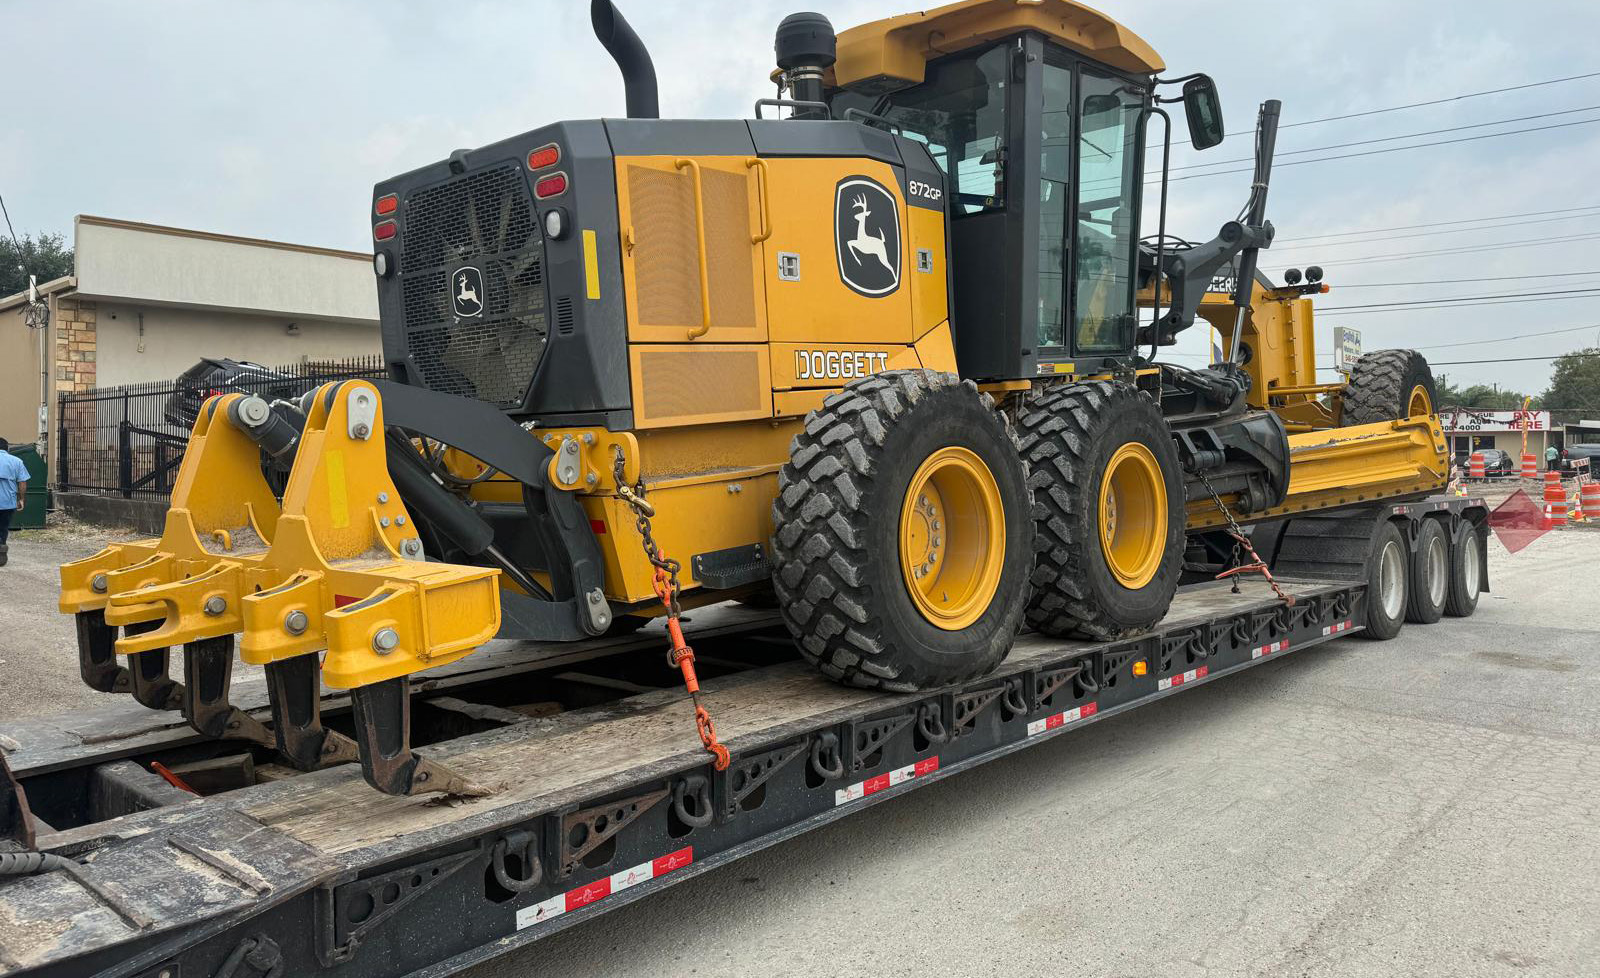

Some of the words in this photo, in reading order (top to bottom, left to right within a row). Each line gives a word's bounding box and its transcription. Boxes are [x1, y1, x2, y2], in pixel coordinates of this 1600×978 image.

[909, 180, 941, 200] 872GP
[794, 350, 888, 379] DOGGETT
[1513, 411, 1540, 420] PAY
[1508, 420, 1543, 429] HERE
